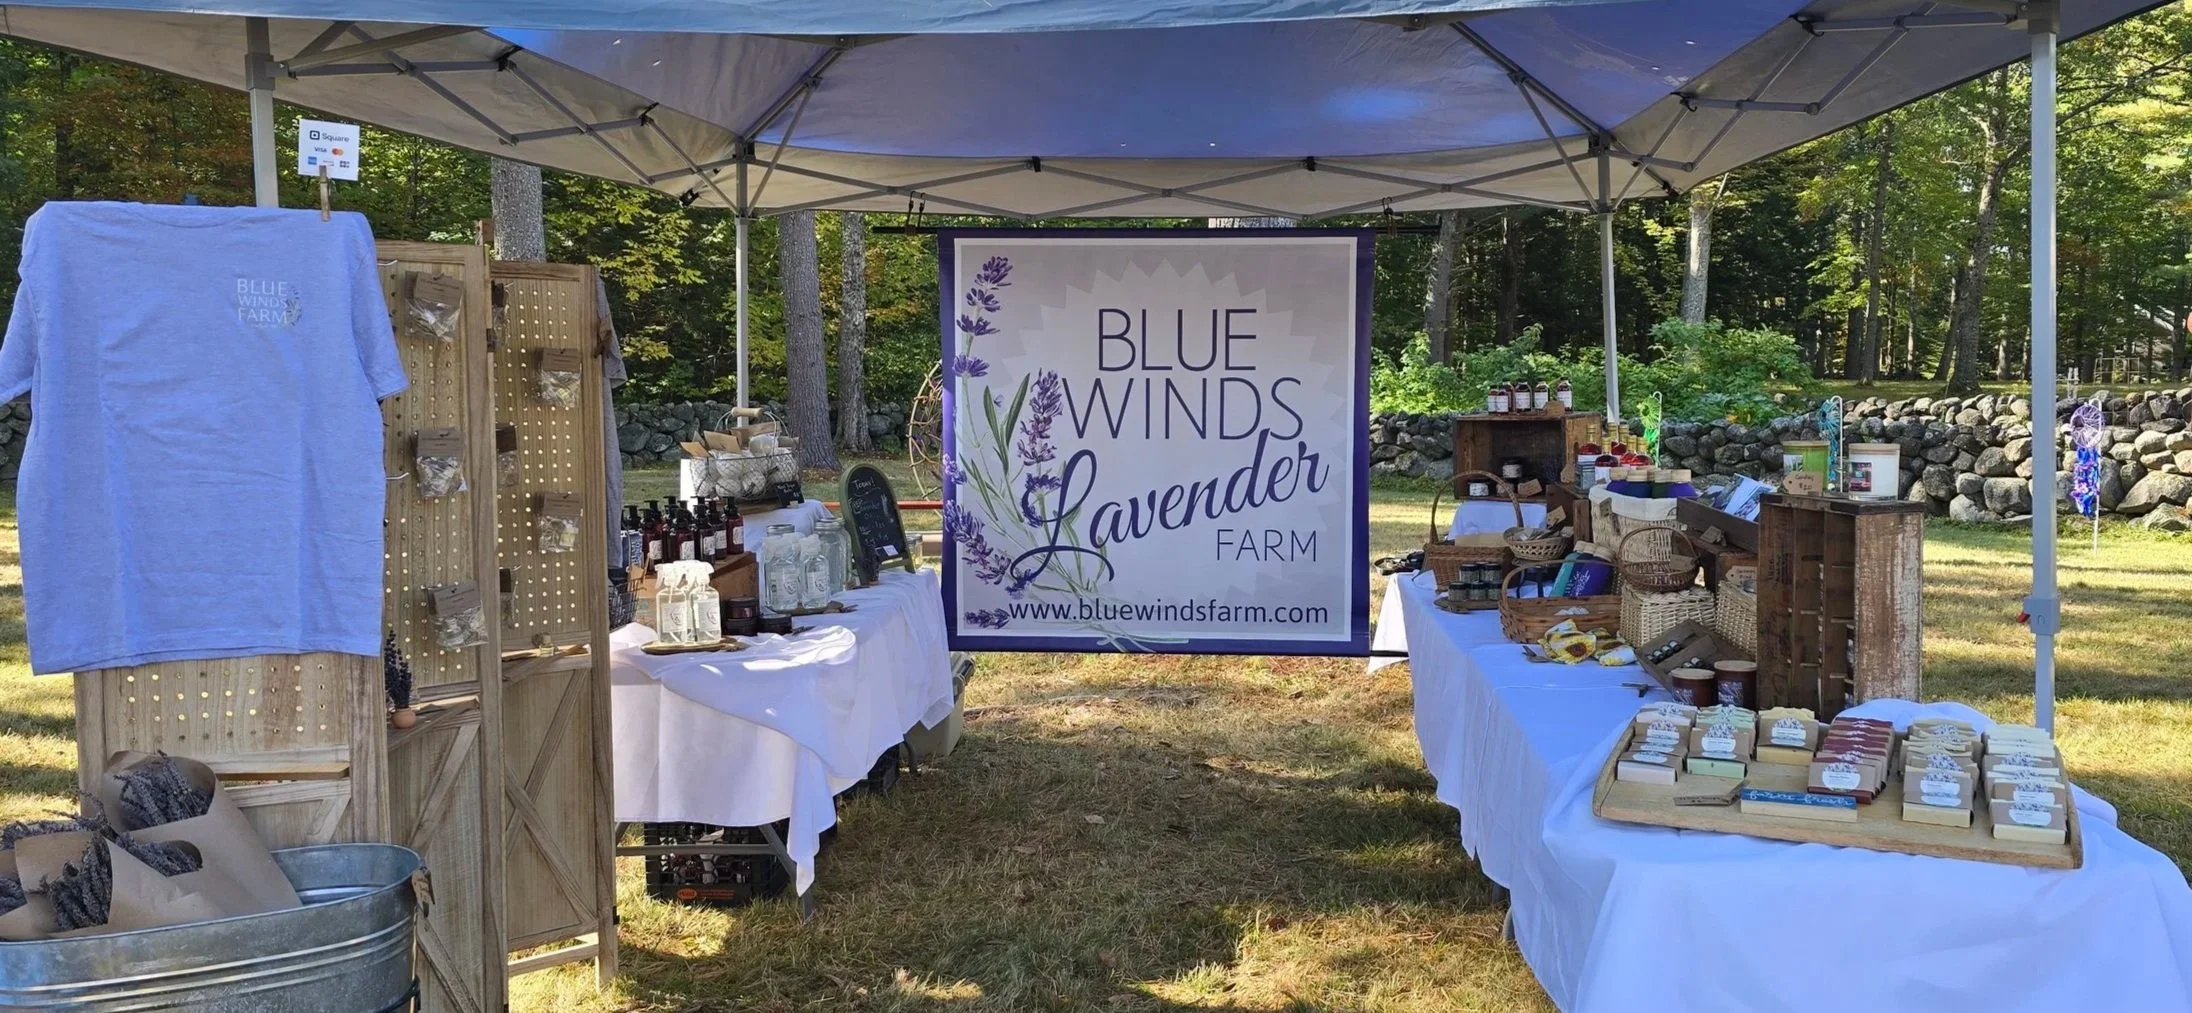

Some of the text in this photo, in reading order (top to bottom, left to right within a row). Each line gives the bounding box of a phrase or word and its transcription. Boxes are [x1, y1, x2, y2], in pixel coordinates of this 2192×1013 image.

[321, 132, 350, 142] Square
[237, 278, 288, 296] BLUE
[238, 295, 288, 309] WINDS
[238, 307, 288, 324] FARM
[1098, 308, 1257, 372] BLUE
[1061, 376, 1304, 440] WINDS
[1009, 427, 1330, 582] Lavender
[1215, 529, 1317, 562] FARM
[1008, 598, 1329, 624] www.bluewindsfarm.com
